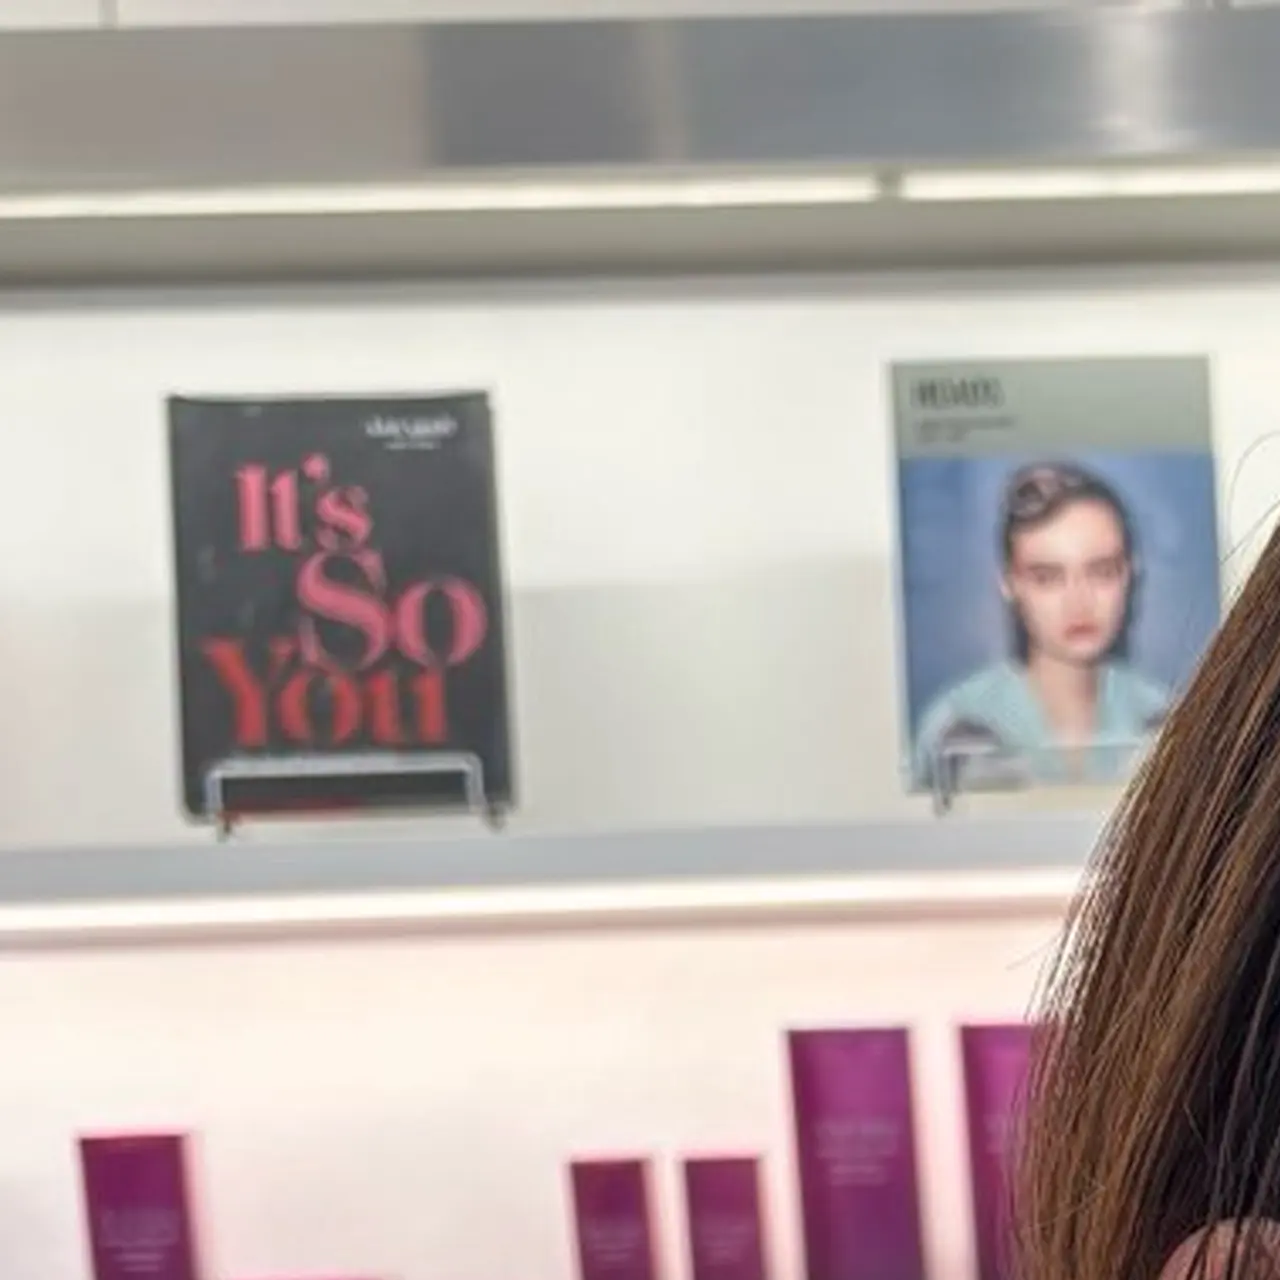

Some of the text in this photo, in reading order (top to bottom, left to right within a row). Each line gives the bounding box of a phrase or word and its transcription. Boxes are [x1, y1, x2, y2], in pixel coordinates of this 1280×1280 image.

[235, 453, 373, 552] It's
[297, 548, 488, 671] So
[201, 636, 449, 747] You
